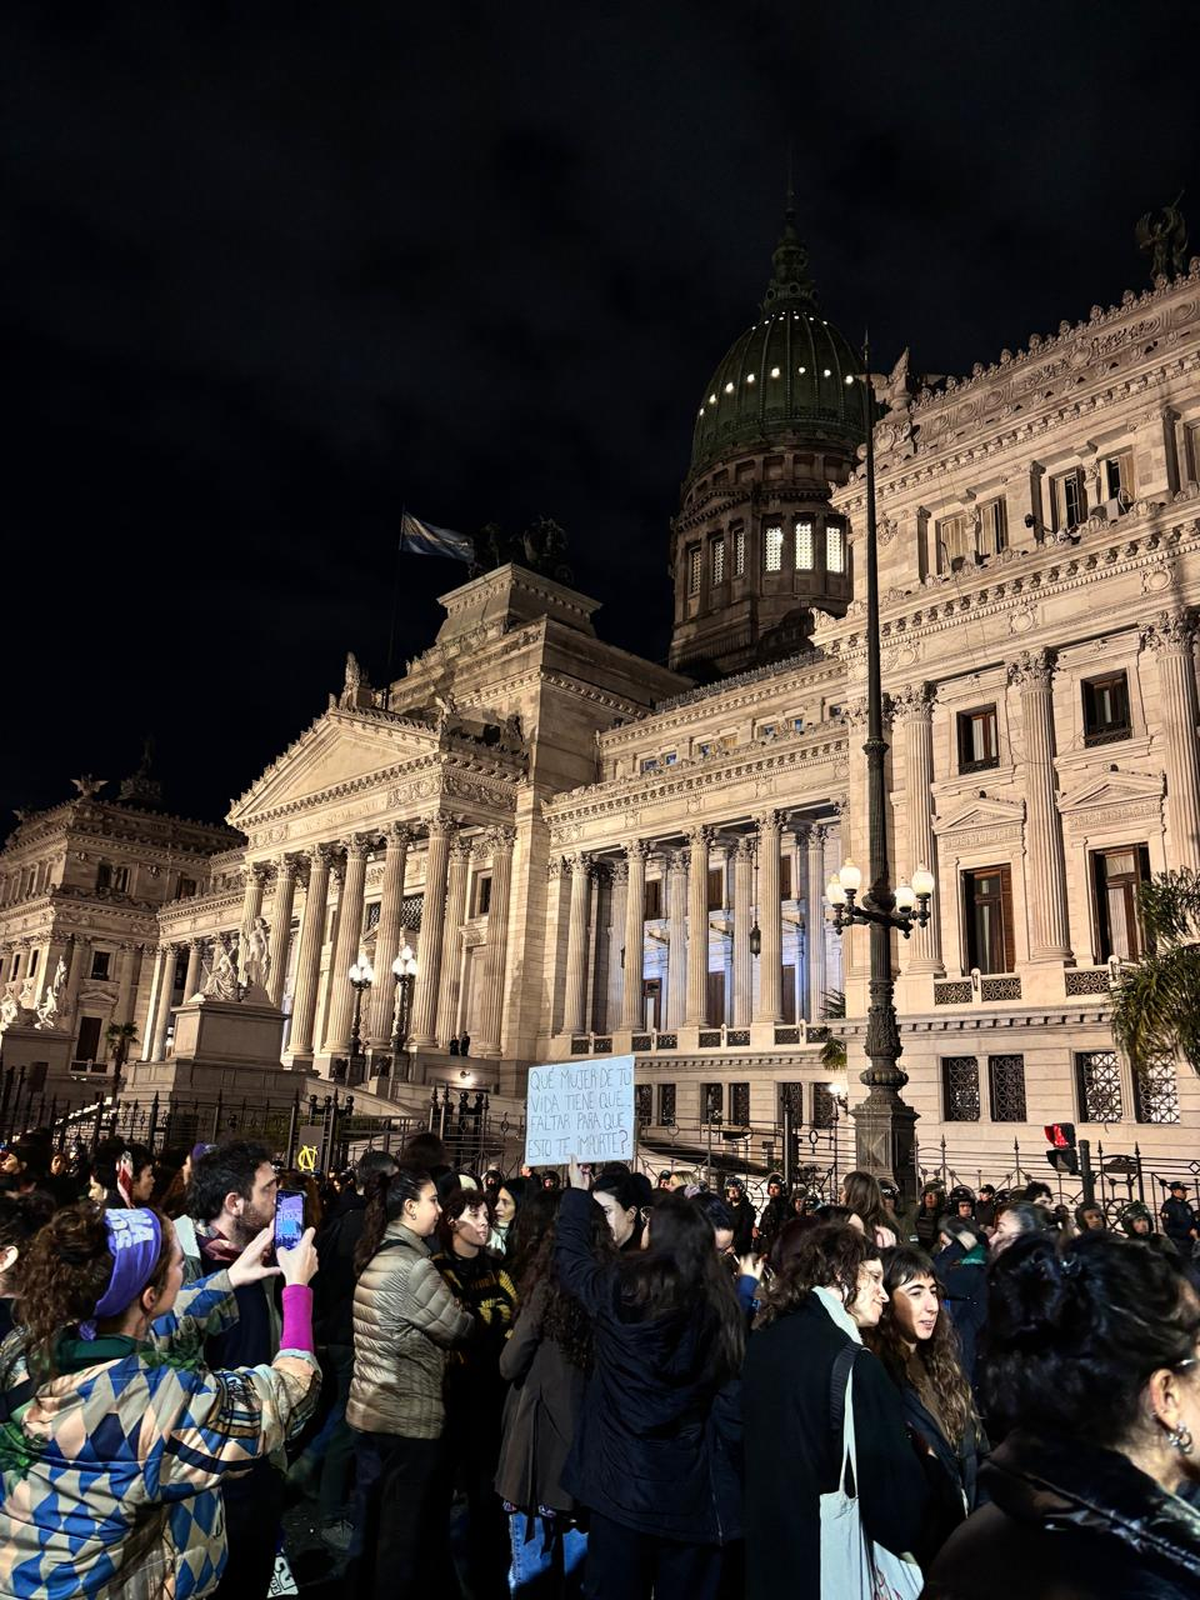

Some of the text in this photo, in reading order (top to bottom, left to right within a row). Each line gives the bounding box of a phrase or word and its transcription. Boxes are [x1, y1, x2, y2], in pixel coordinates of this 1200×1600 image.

[530, 1067, 555, 1091] QUÉ
[560, 1068, 597, 1090] MUJER
[600, 1067, 614, 1088] DE
[531, 1094, 560, 1113] VIDA
[564, 1091, 594, 1111] TIENE
[531, 1112, 625, 1131] FALTAR PARA QUE
[529, 1138, 551, 1158] ESTO
[555, 1136, 571, 1157] TE
